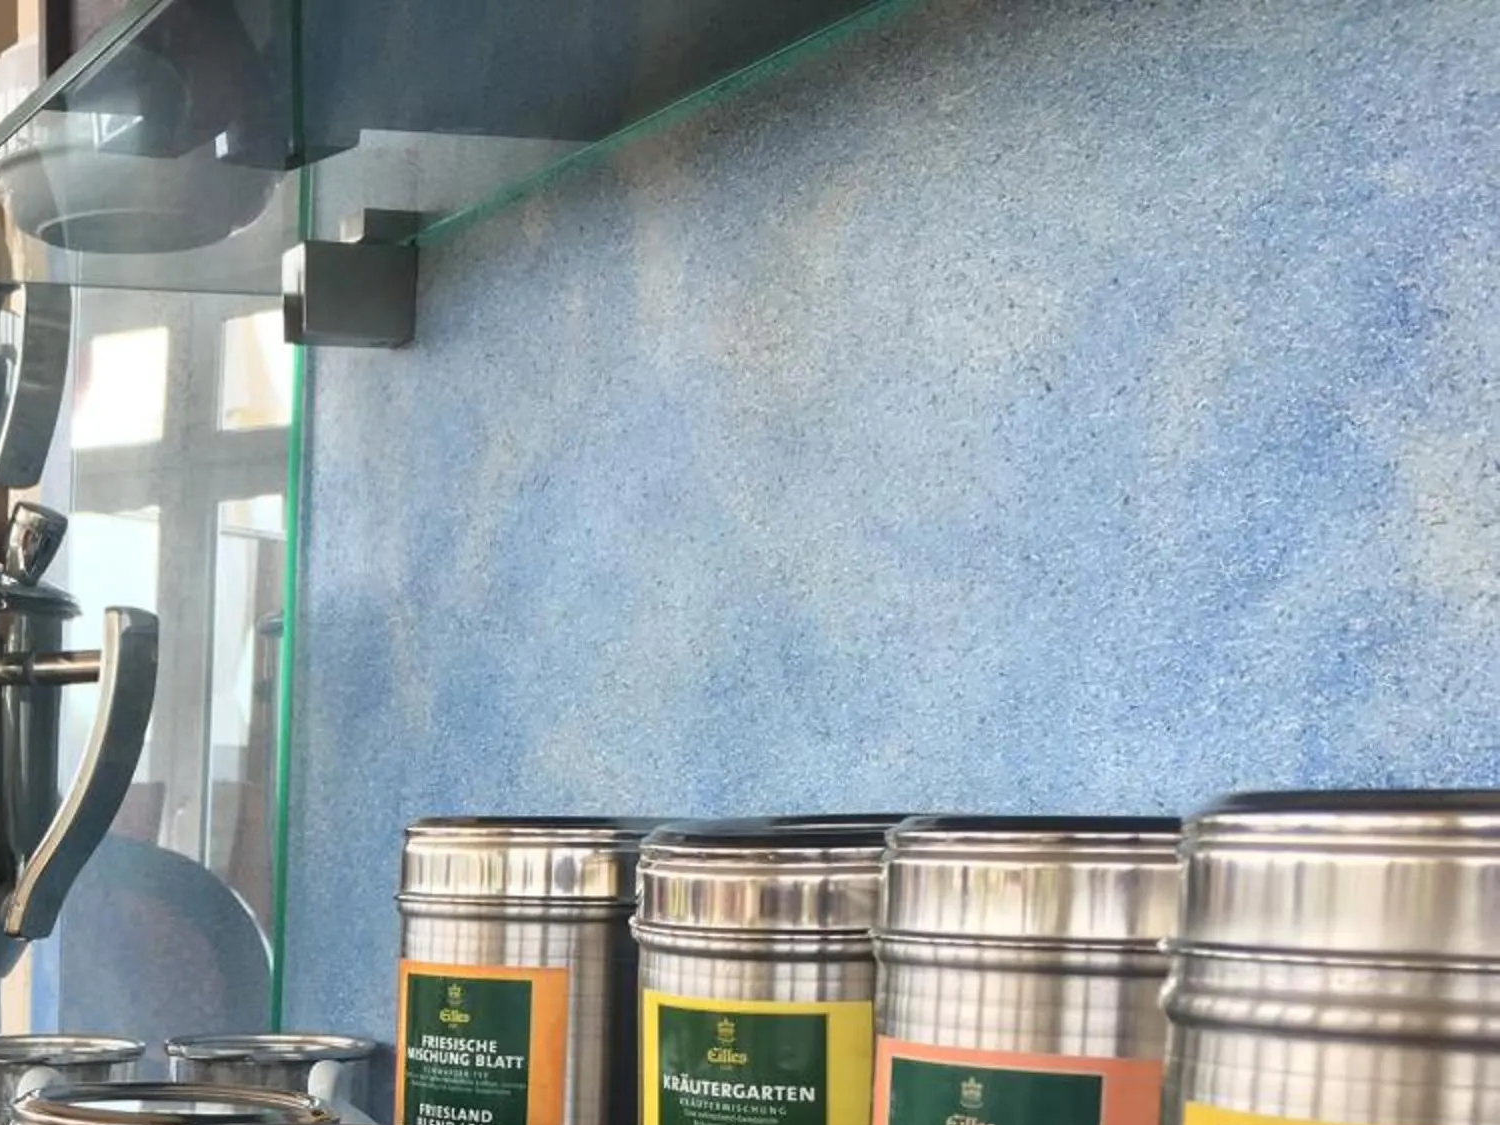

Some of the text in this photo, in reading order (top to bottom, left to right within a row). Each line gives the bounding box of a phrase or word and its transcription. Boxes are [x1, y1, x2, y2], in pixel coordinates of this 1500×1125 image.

[422, 1035, 497, 1053] FRIESISCHE
[407, 1048, 524, 1069] MISCHUNG BLATT
[663, 1073, 815, 1102] KRÄUTERGARTEN
[420, 1103, 493, 1123] FRIESLAND
[680, 1098, 786, 1115] KRÄUTERMISCHUNG
